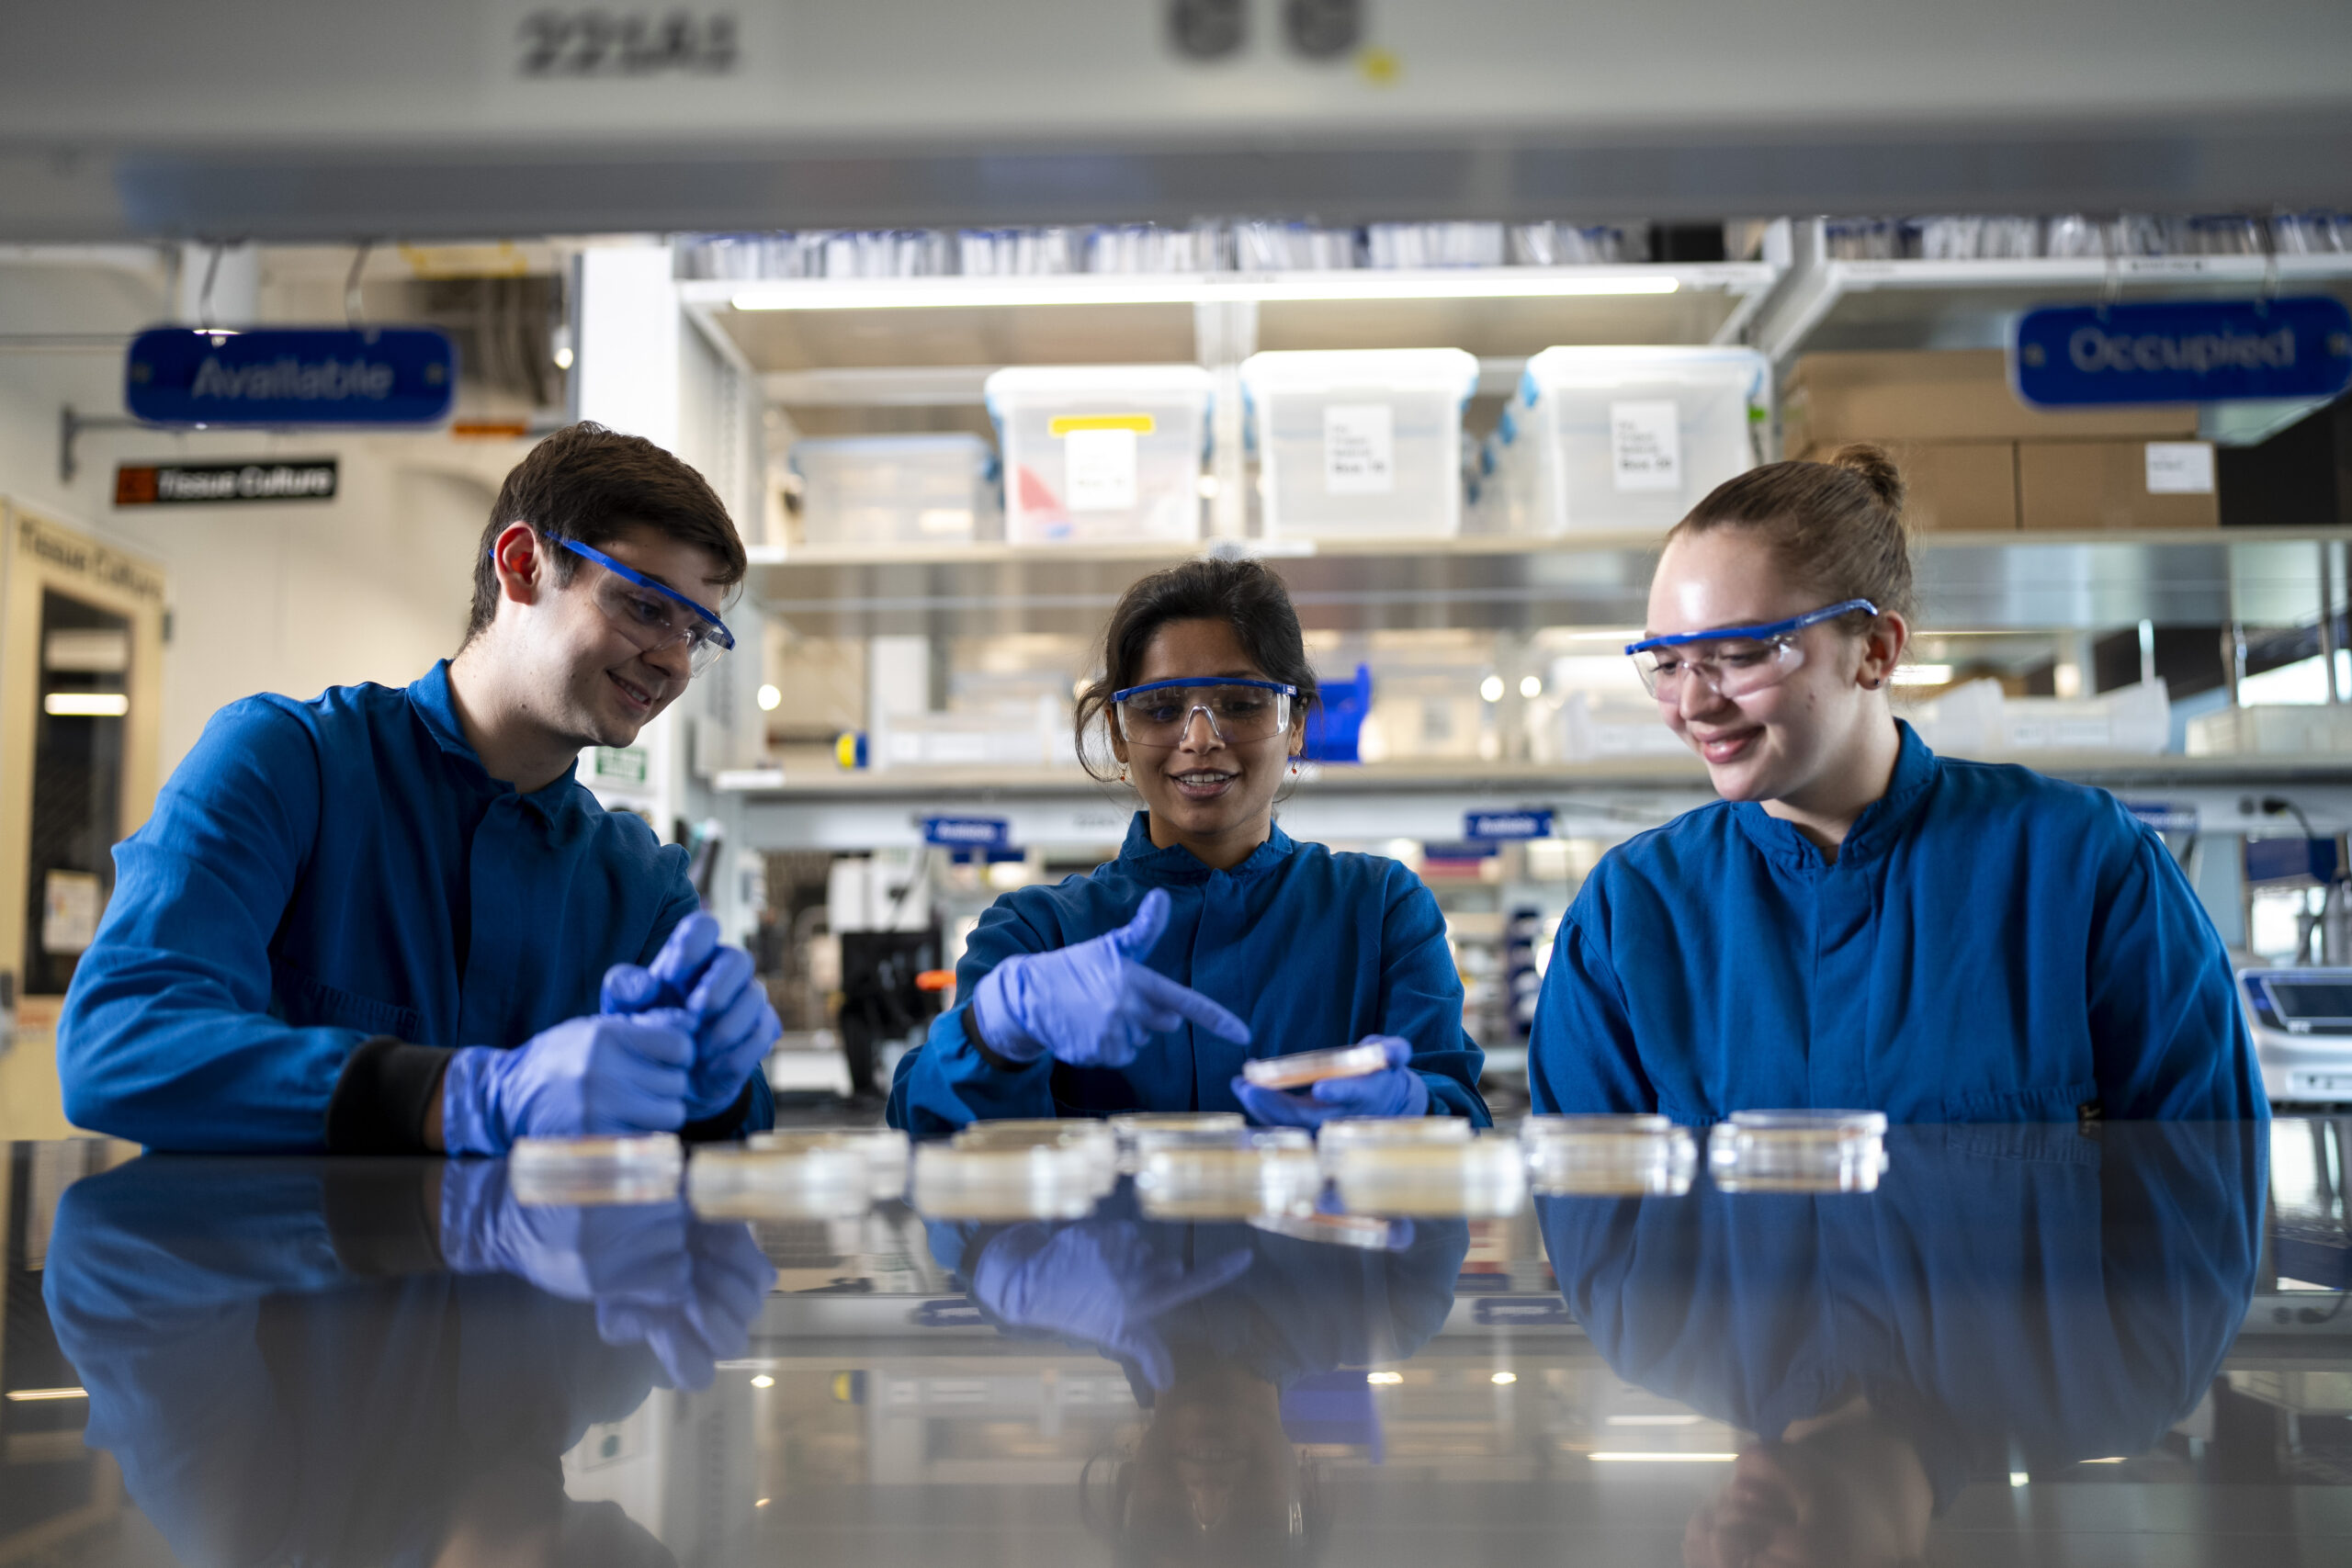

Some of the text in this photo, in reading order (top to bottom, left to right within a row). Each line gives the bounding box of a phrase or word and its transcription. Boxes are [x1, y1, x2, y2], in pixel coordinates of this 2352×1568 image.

[2069, 325, 2296, 378] Occupied
[191, 355, 393, 400] Available
[157, 465, 334, 499] Tissue Culture
[19, 518, 87, 573] Tissue
